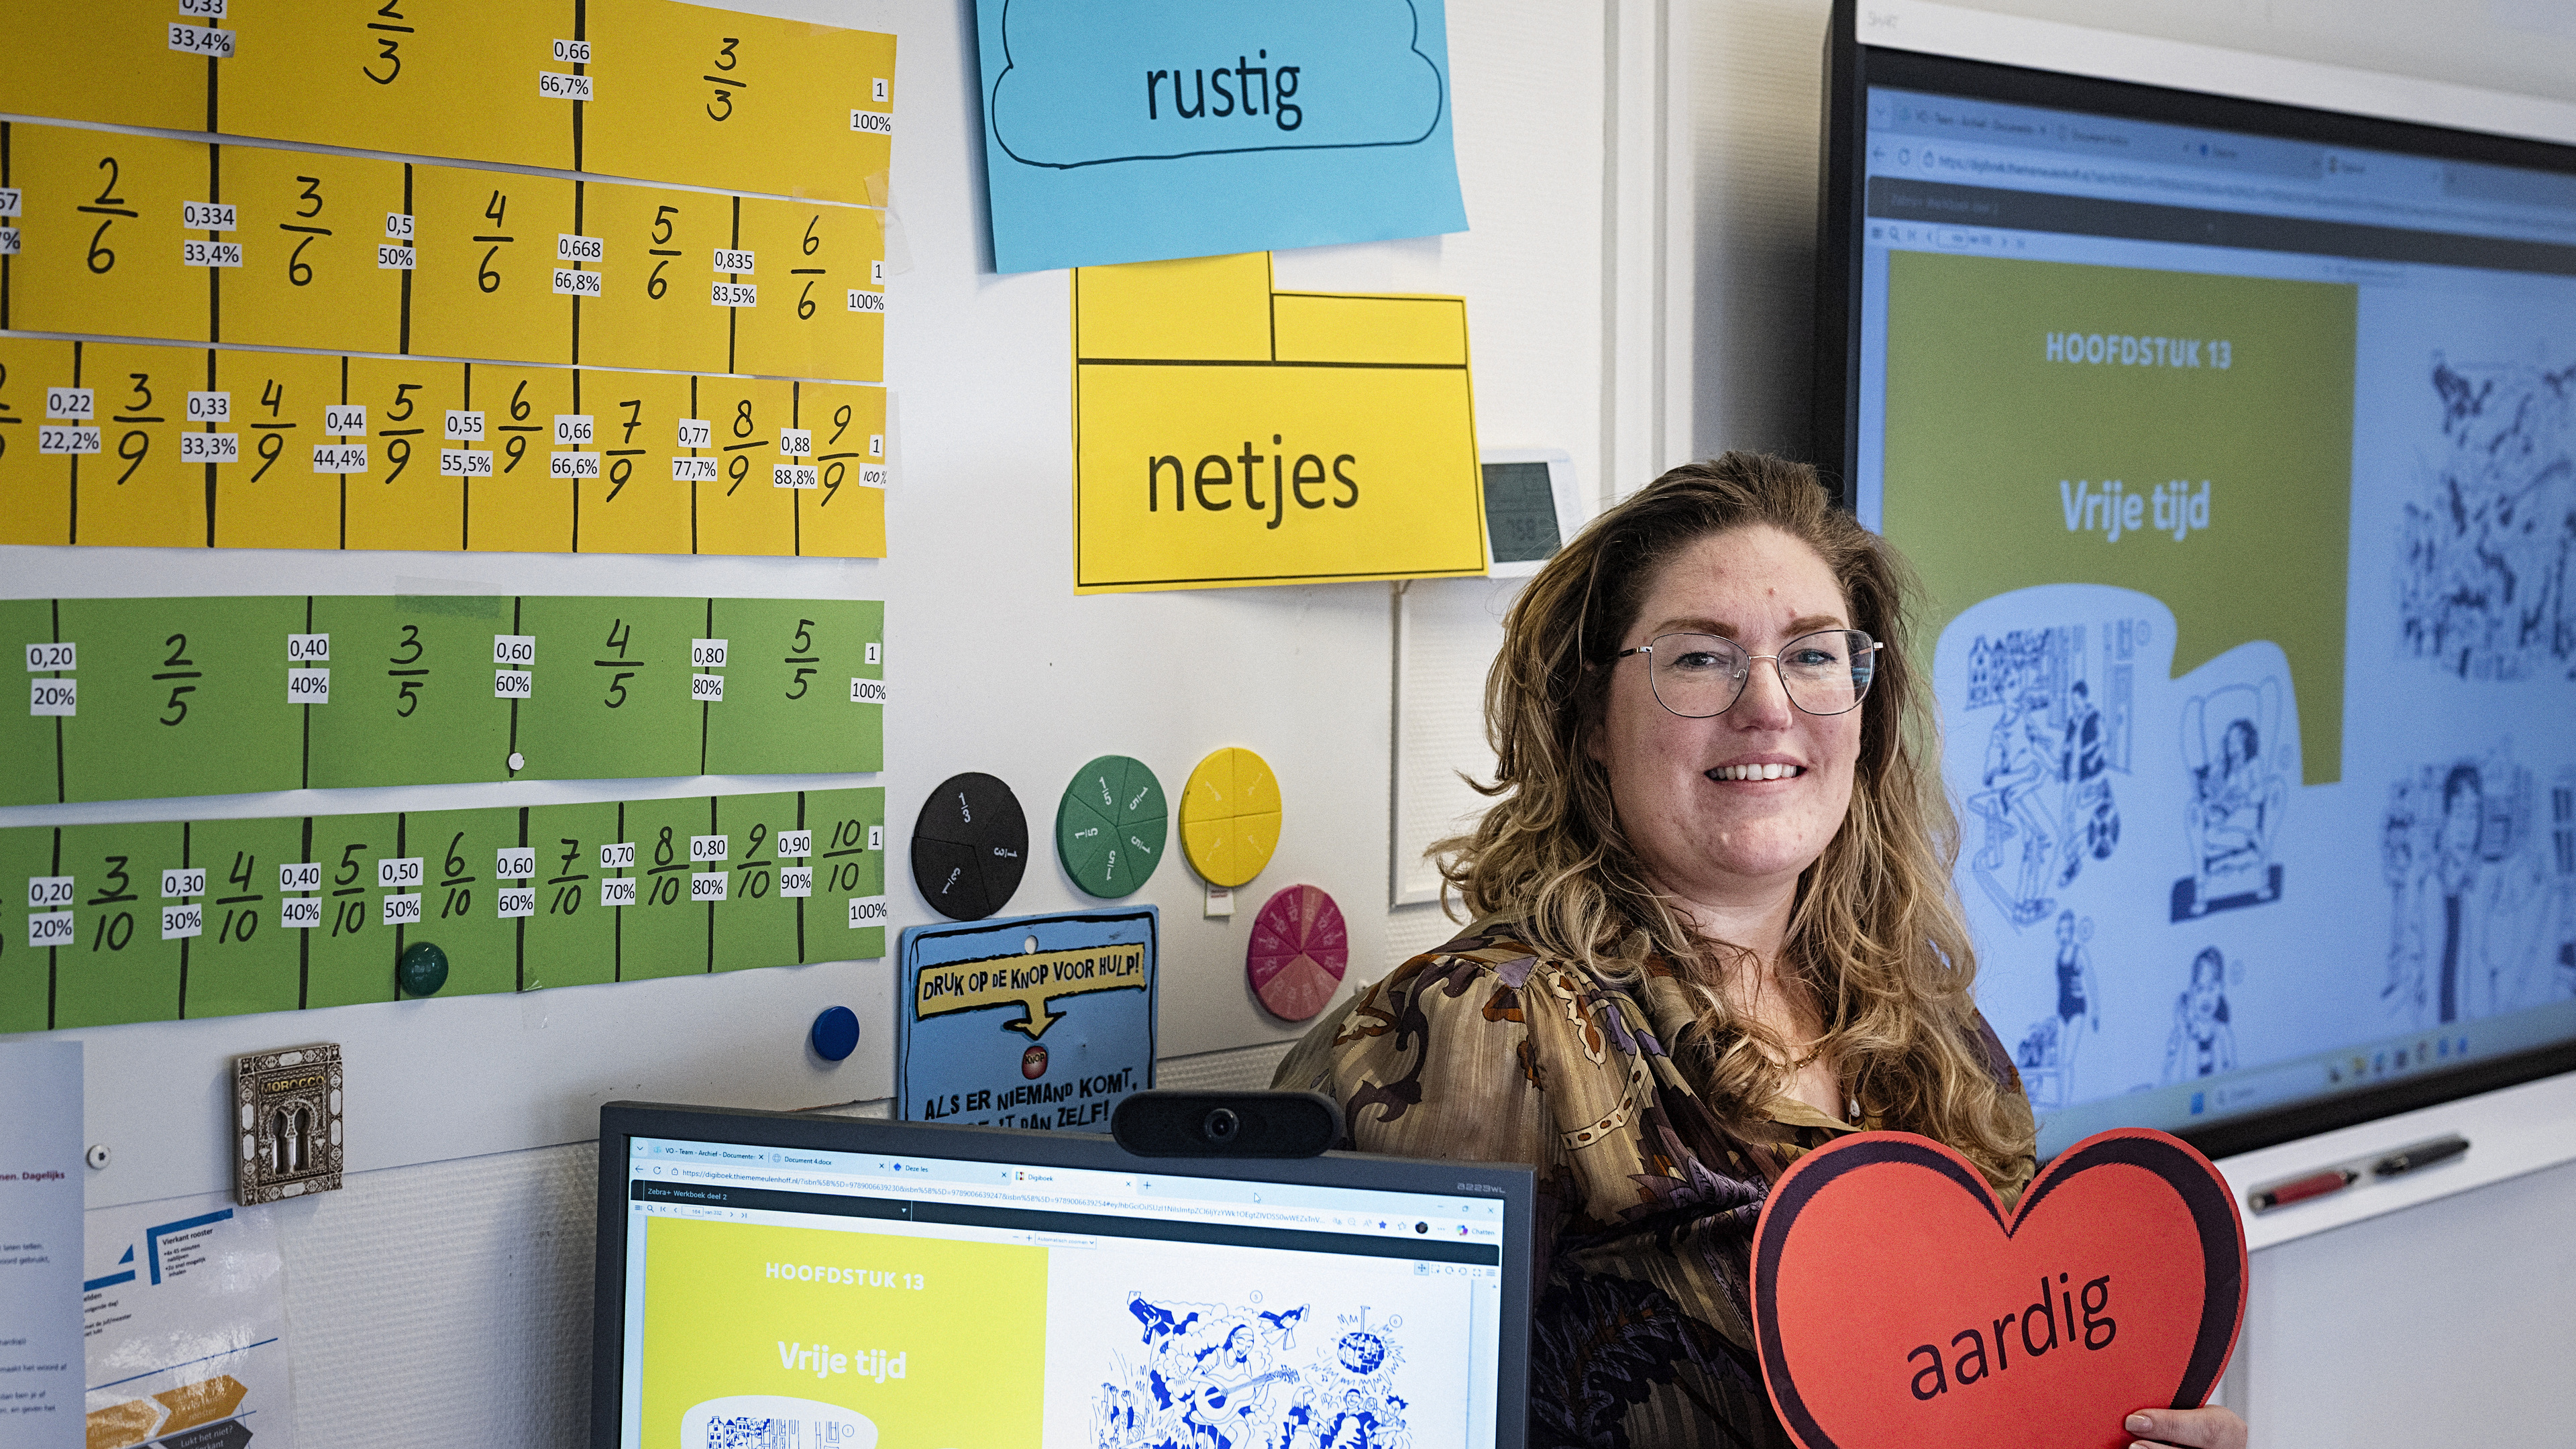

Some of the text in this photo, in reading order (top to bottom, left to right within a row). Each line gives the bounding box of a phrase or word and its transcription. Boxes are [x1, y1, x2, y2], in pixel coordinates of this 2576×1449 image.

[172, 28, 230, 52] 33,4%
[555, 42, 590, 61] 0,66
[541, 76, 589, 96] 66,7%
[876, 83, 884, 97] 1
[1146, 49, 1303, 131] rustig
[853, 114, 891, 132] 100%
[184, 206, 234, 227] 0,334
[388, 216, 413, 235] 0,5
[184, 244, 239, 265] 33,4%
[378, 248, 413, 268] 50%
[559, 240, 600, 259] 0,668
[715, 253, 752, 272] 0,835
[875, 265, 881, 279] 1
[555, 272, 600, 292] 66,8%
[713, 285, 755, 305] 83,5%
[849, 294, 884, 311] 100%
[2046, 333, 2231, 369] HOOFDSTUK 13
[50, 394, 91, 416] 0,22
[190, 398, 227, 417] 0,33
[327, 413, 363, 432] 0,44
[447, 417, 482, 435] 0,55
[559, 423, 591, 441] 0,66
[42, 432, 99, 451] 22,2%
[680, 428, 708, 445] 0,77
[782, 437, 810, 455] 0,88
[873, 439, 879, 453] 1
[182, 437, 236, 457] 33,3%
[314, 449, 365, 469] 44,4%
[442, 455, 490, 474] 55,5%
[552, 458, 598, 476] 66,6%
[674, 462, 716, 480] 77,7%
[775, 470, 814, 487] 88,8%
[864, 471, 887, 484] 100%
[1148, 434, 1359, 530] netjes
[2059, 480, 2210, 543] Vrije tijd
[30, 648, 72, 669] 0,20
[290, 639, 327, 659] 0,40
[496, 643, 531, 662] 0,60
[694, 647, 724, 665] 0,80
[869, 647, 875, 661] 1
[291, 677, 327, 695] 40%
[496, 676, 529, 693] 60%
[693, 680, 721, 696] 80%
[853, 683, 885, 700] 100%
[34, 688, 75, 706] 20%
[780, 836, 810, 855] 0,90
[872, 833, 879, 846] 1
[602, 847, 634, 865] 0,70
[693, 840, 725, 859] 0,80
[382, 863, 418, 883] 0,50
[497, 858, 533, 877] 0,60
[165, 875, 203, 896] 0,30
[282, 869, 319, 888] 0,40
[692, 879, 723, 896] 80%
[782, 873, 811, 890] 90%
[32, 884, 72, 904] 0,20
[605, 884, 635, 900] 70%
[284, 903, 319, 921] 40%
[386, 901, 419, 918] 50%
[499, 895, 533, 912] 60%
[851, 903, 886, 920] 100%
[33, 918, 72, 937] 20%
[164, 911, 201, 930] 30%
[922, 953, 1139, 1000] DRUK OP DE KNOP VOOR HULP!
[1025, 1053, 1044, 1064] KNOP
[261, 1076, 324, 1093] MOROCCO
[924, 1067, 1137, 1121] ALS ER NIEMAND KOMT,
[1057, 1099, 1110, 1128] ZELF!
[22, 1171, 65, 1181] Dagelijks
[674, 1190, 705, 1199] Werkboek
[162, 1229, 213, 1245] Vierkant rooster
[180, 1244, 200, 1252] minuten
[765, 1263, 924, 1291] HOOFDSTUK 13
[1907, 1272, 2116, 1401] aardig
[778, 1341, 906, 1383] Vrije tijd
[181, 1437, 197, 1448] Lukt
[200, 1432, 211, 1442] het
[214, 1425, 233, 1438] niet?
